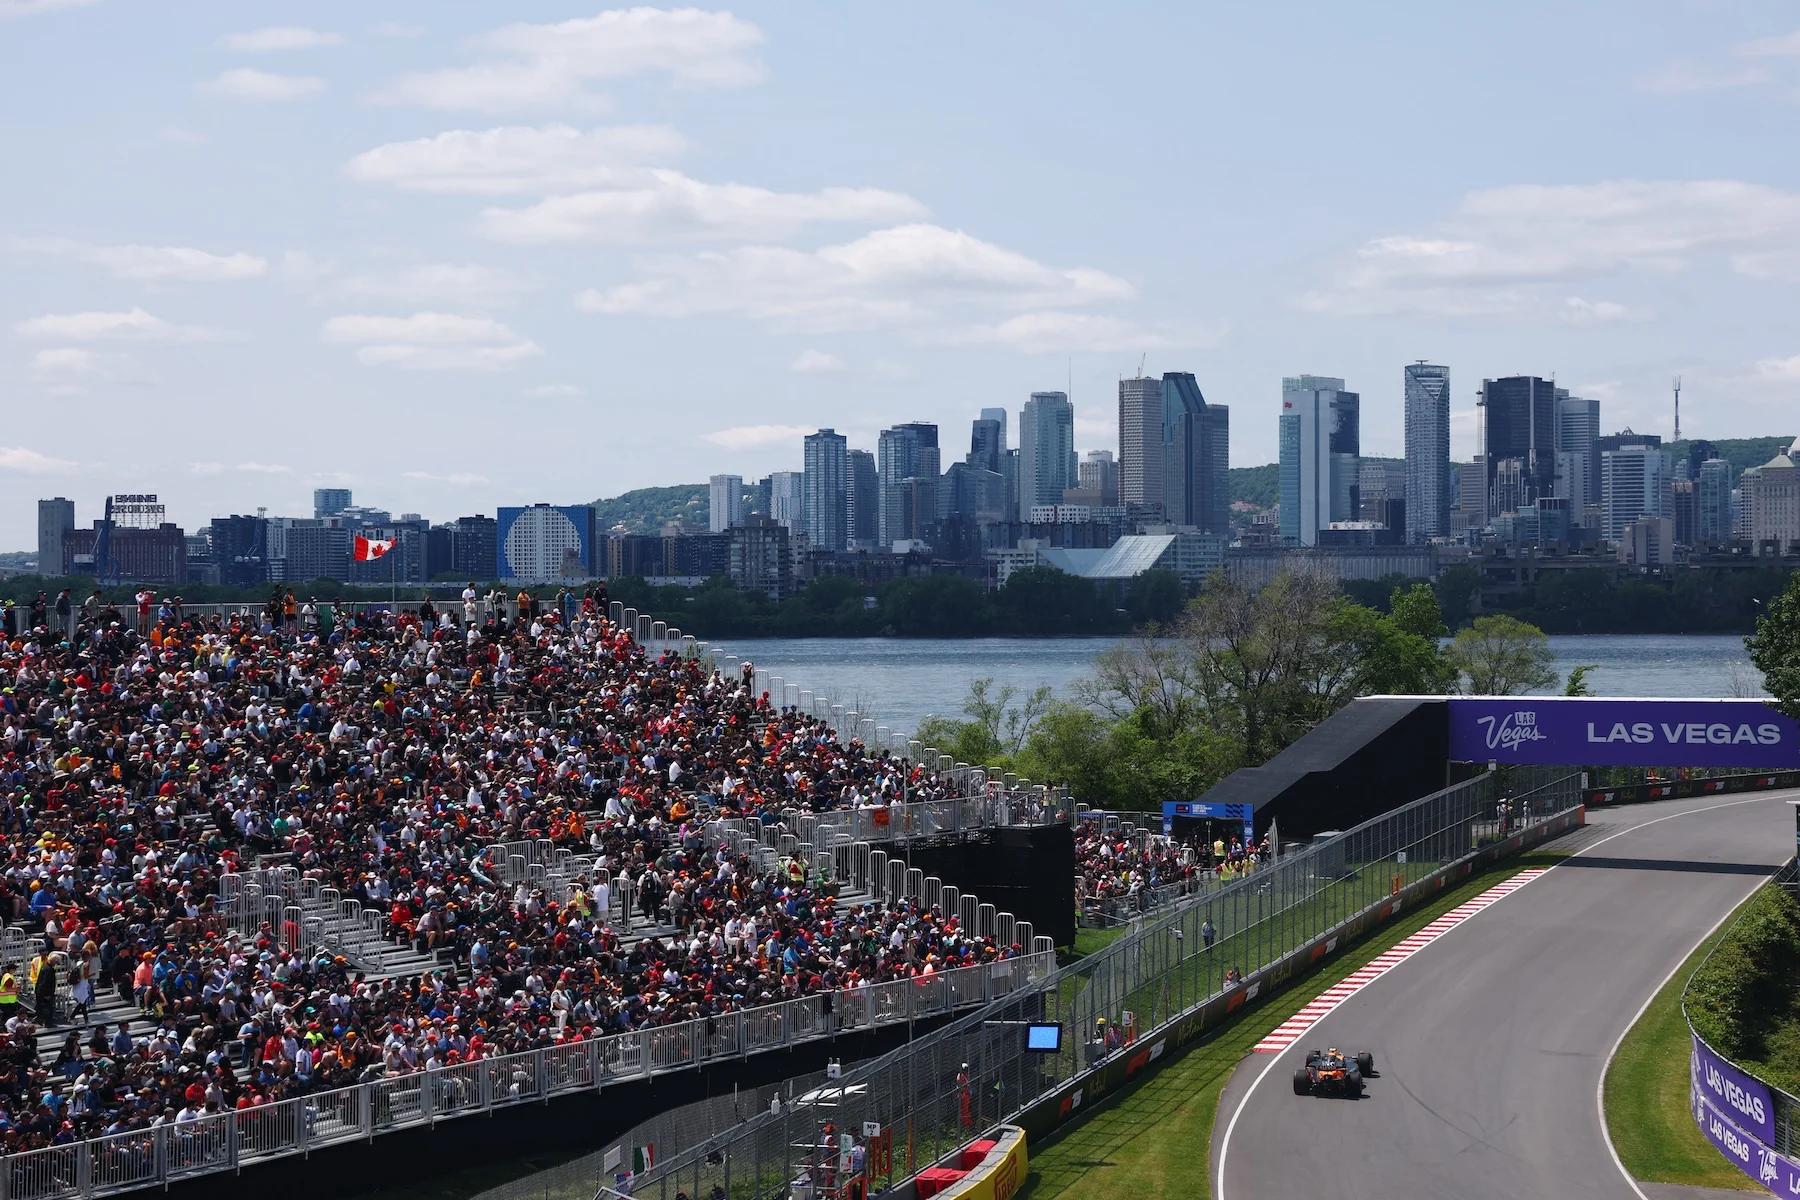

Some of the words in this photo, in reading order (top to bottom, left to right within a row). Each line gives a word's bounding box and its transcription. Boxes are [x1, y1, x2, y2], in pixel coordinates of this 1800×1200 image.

[1477, 713, 1547, 751] Vegas
[1515, 712, 1536, 725] LAS
[1587, 722, 1655, 743] LAS
[1660, 723, 1781, 744] VEGAS
[1148, 1037, 1166, 1062] 75
[1704, 1060, 1722, 1096] LAS
[1721, 1075, 1766, 1125] VEGAS
[1710, 1114, 1722, 1141] LAS
[1723, 1127, 1750, 1162] VEGAS
